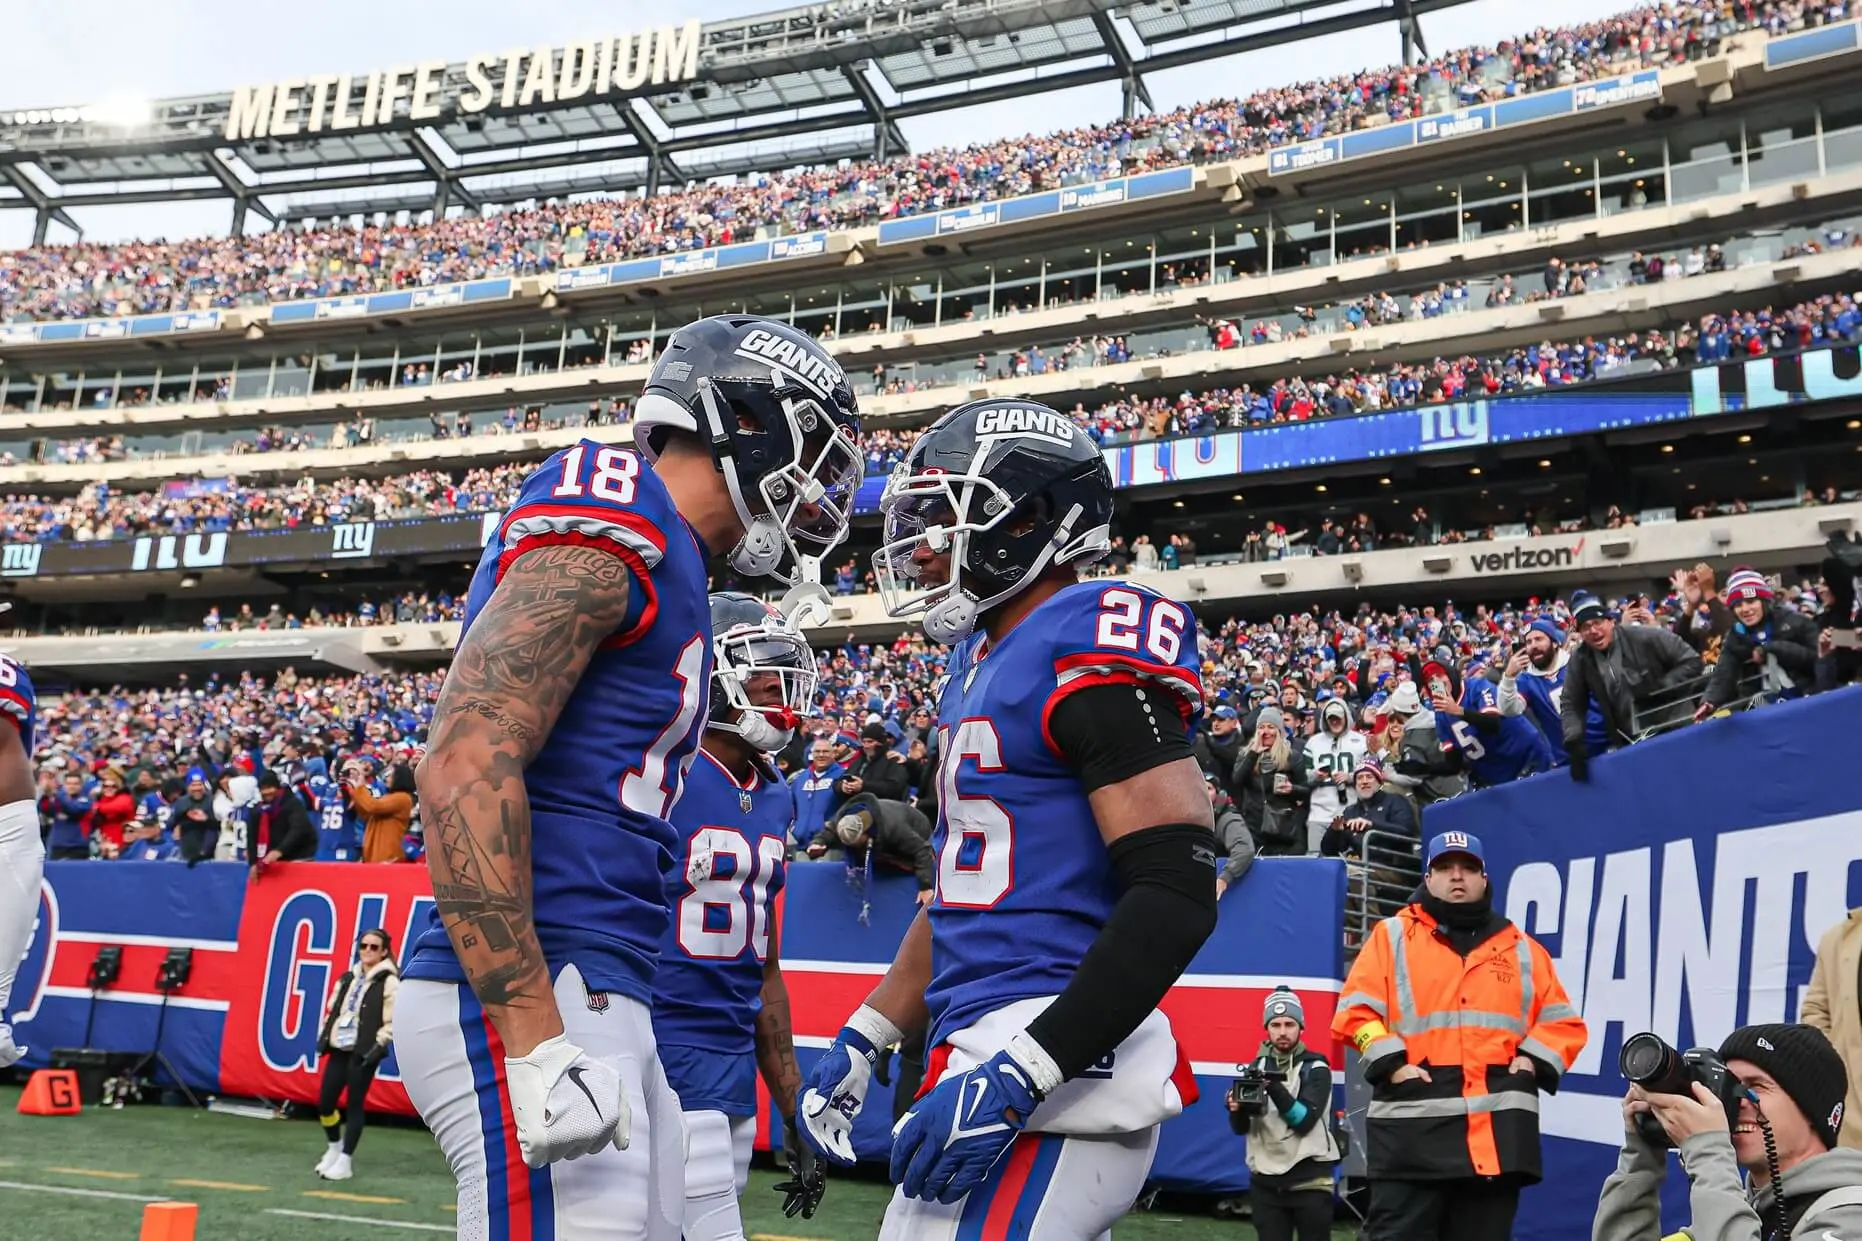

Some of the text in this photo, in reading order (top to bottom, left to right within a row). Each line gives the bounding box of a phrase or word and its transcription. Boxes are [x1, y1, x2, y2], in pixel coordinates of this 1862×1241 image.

[225, 17, 702, 141] METLIFE STADIUM
[739, 328, 843, 395] GIANTS
[974, 408, 1075, 440] GIANTS
[552, 443, 641, 505] 18
[1470, 545, 1573, 572] verizon
[1094, 586, 1187, 666] 26
[617, 630, 712, 824] 1
[1451, 719, 1486, 761] 5
[934, 715, 1016, 911] 6
[675, 825, 786, 961] 80
[47, 1075, 74, 1108] G
